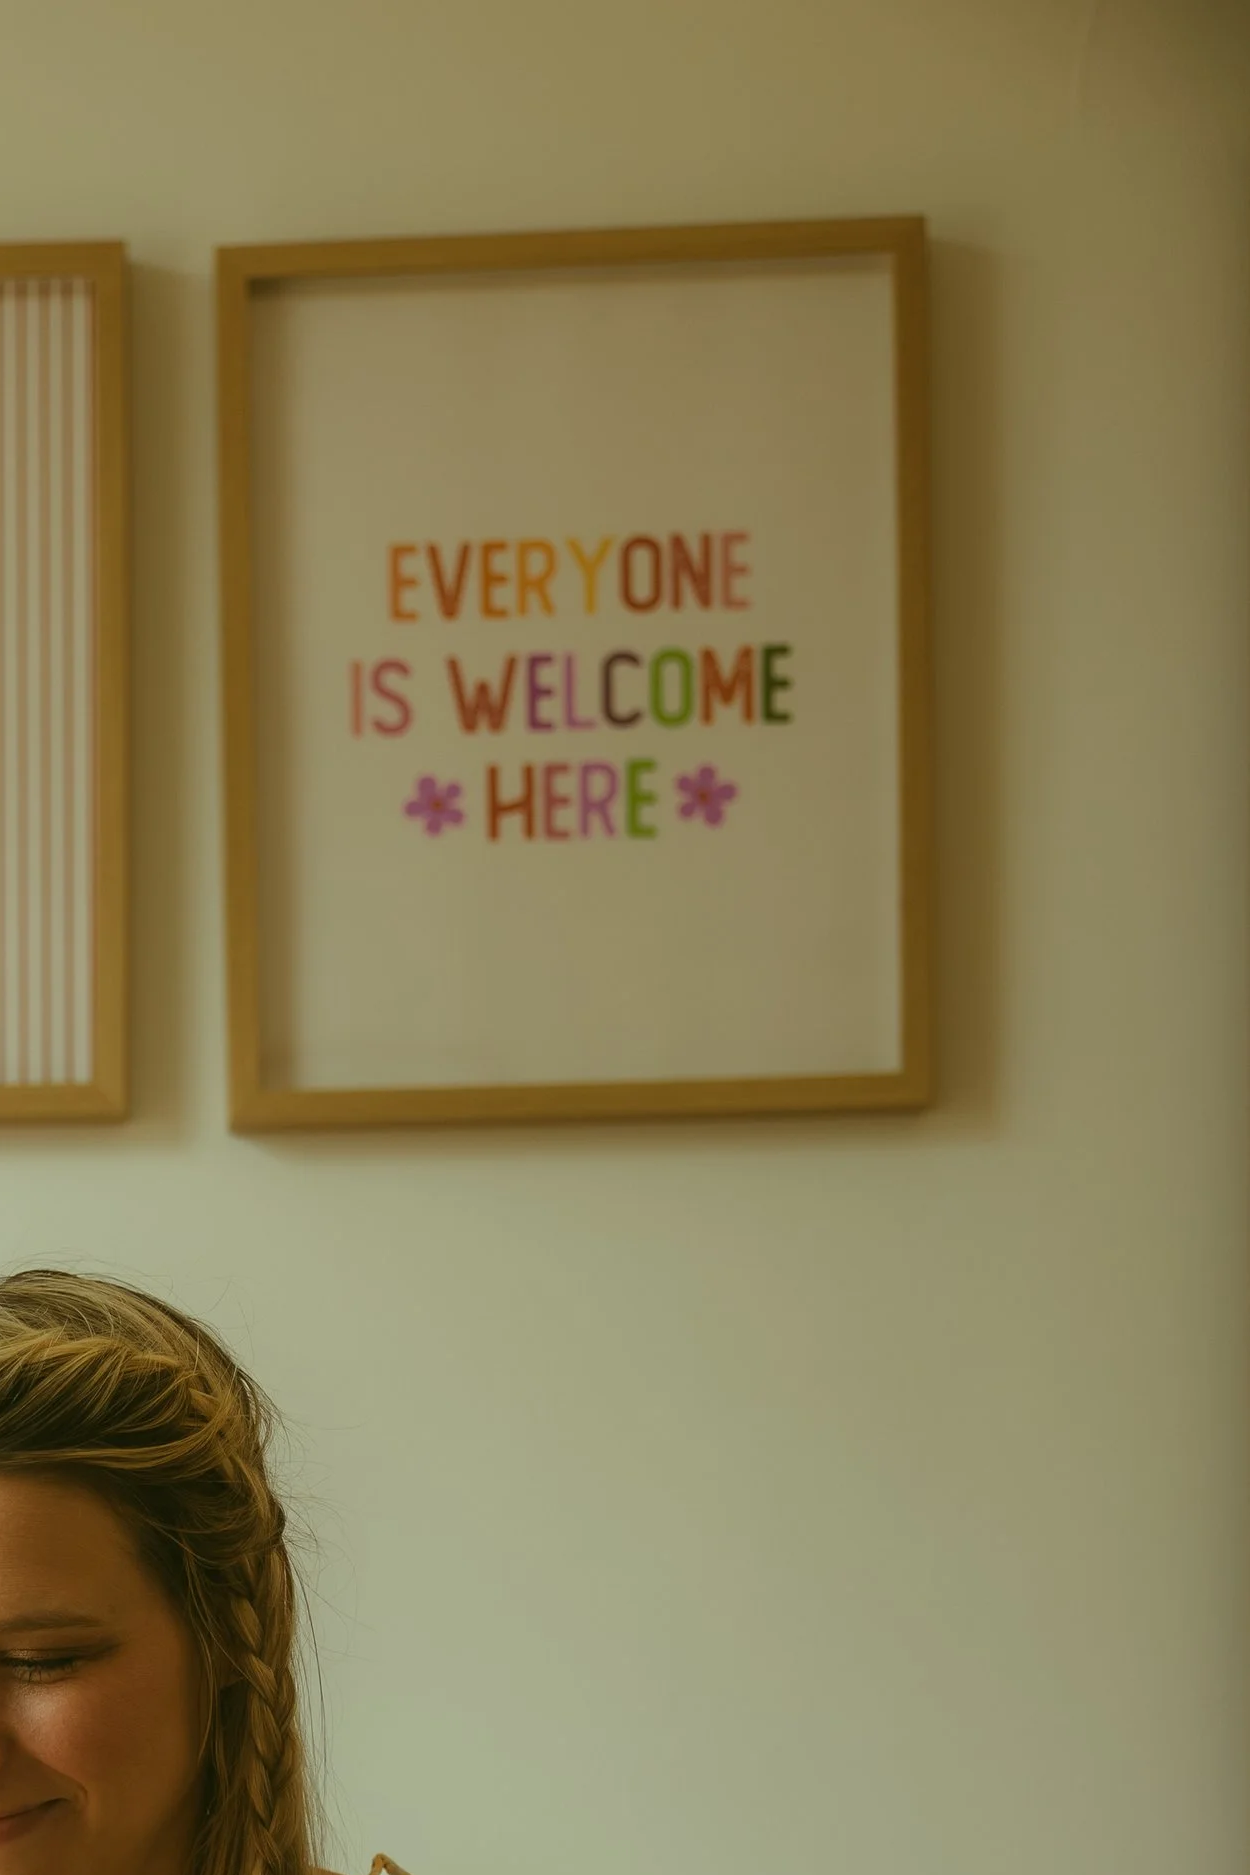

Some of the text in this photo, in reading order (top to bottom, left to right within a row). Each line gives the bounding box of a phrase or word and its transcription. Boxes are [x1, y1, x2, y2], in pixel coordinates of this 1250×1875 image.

[390, 532, 750, 621] EVERYONE
[349, 643, 792, 737] IS WELCOME
[487, 758, 657, 841] HERE
